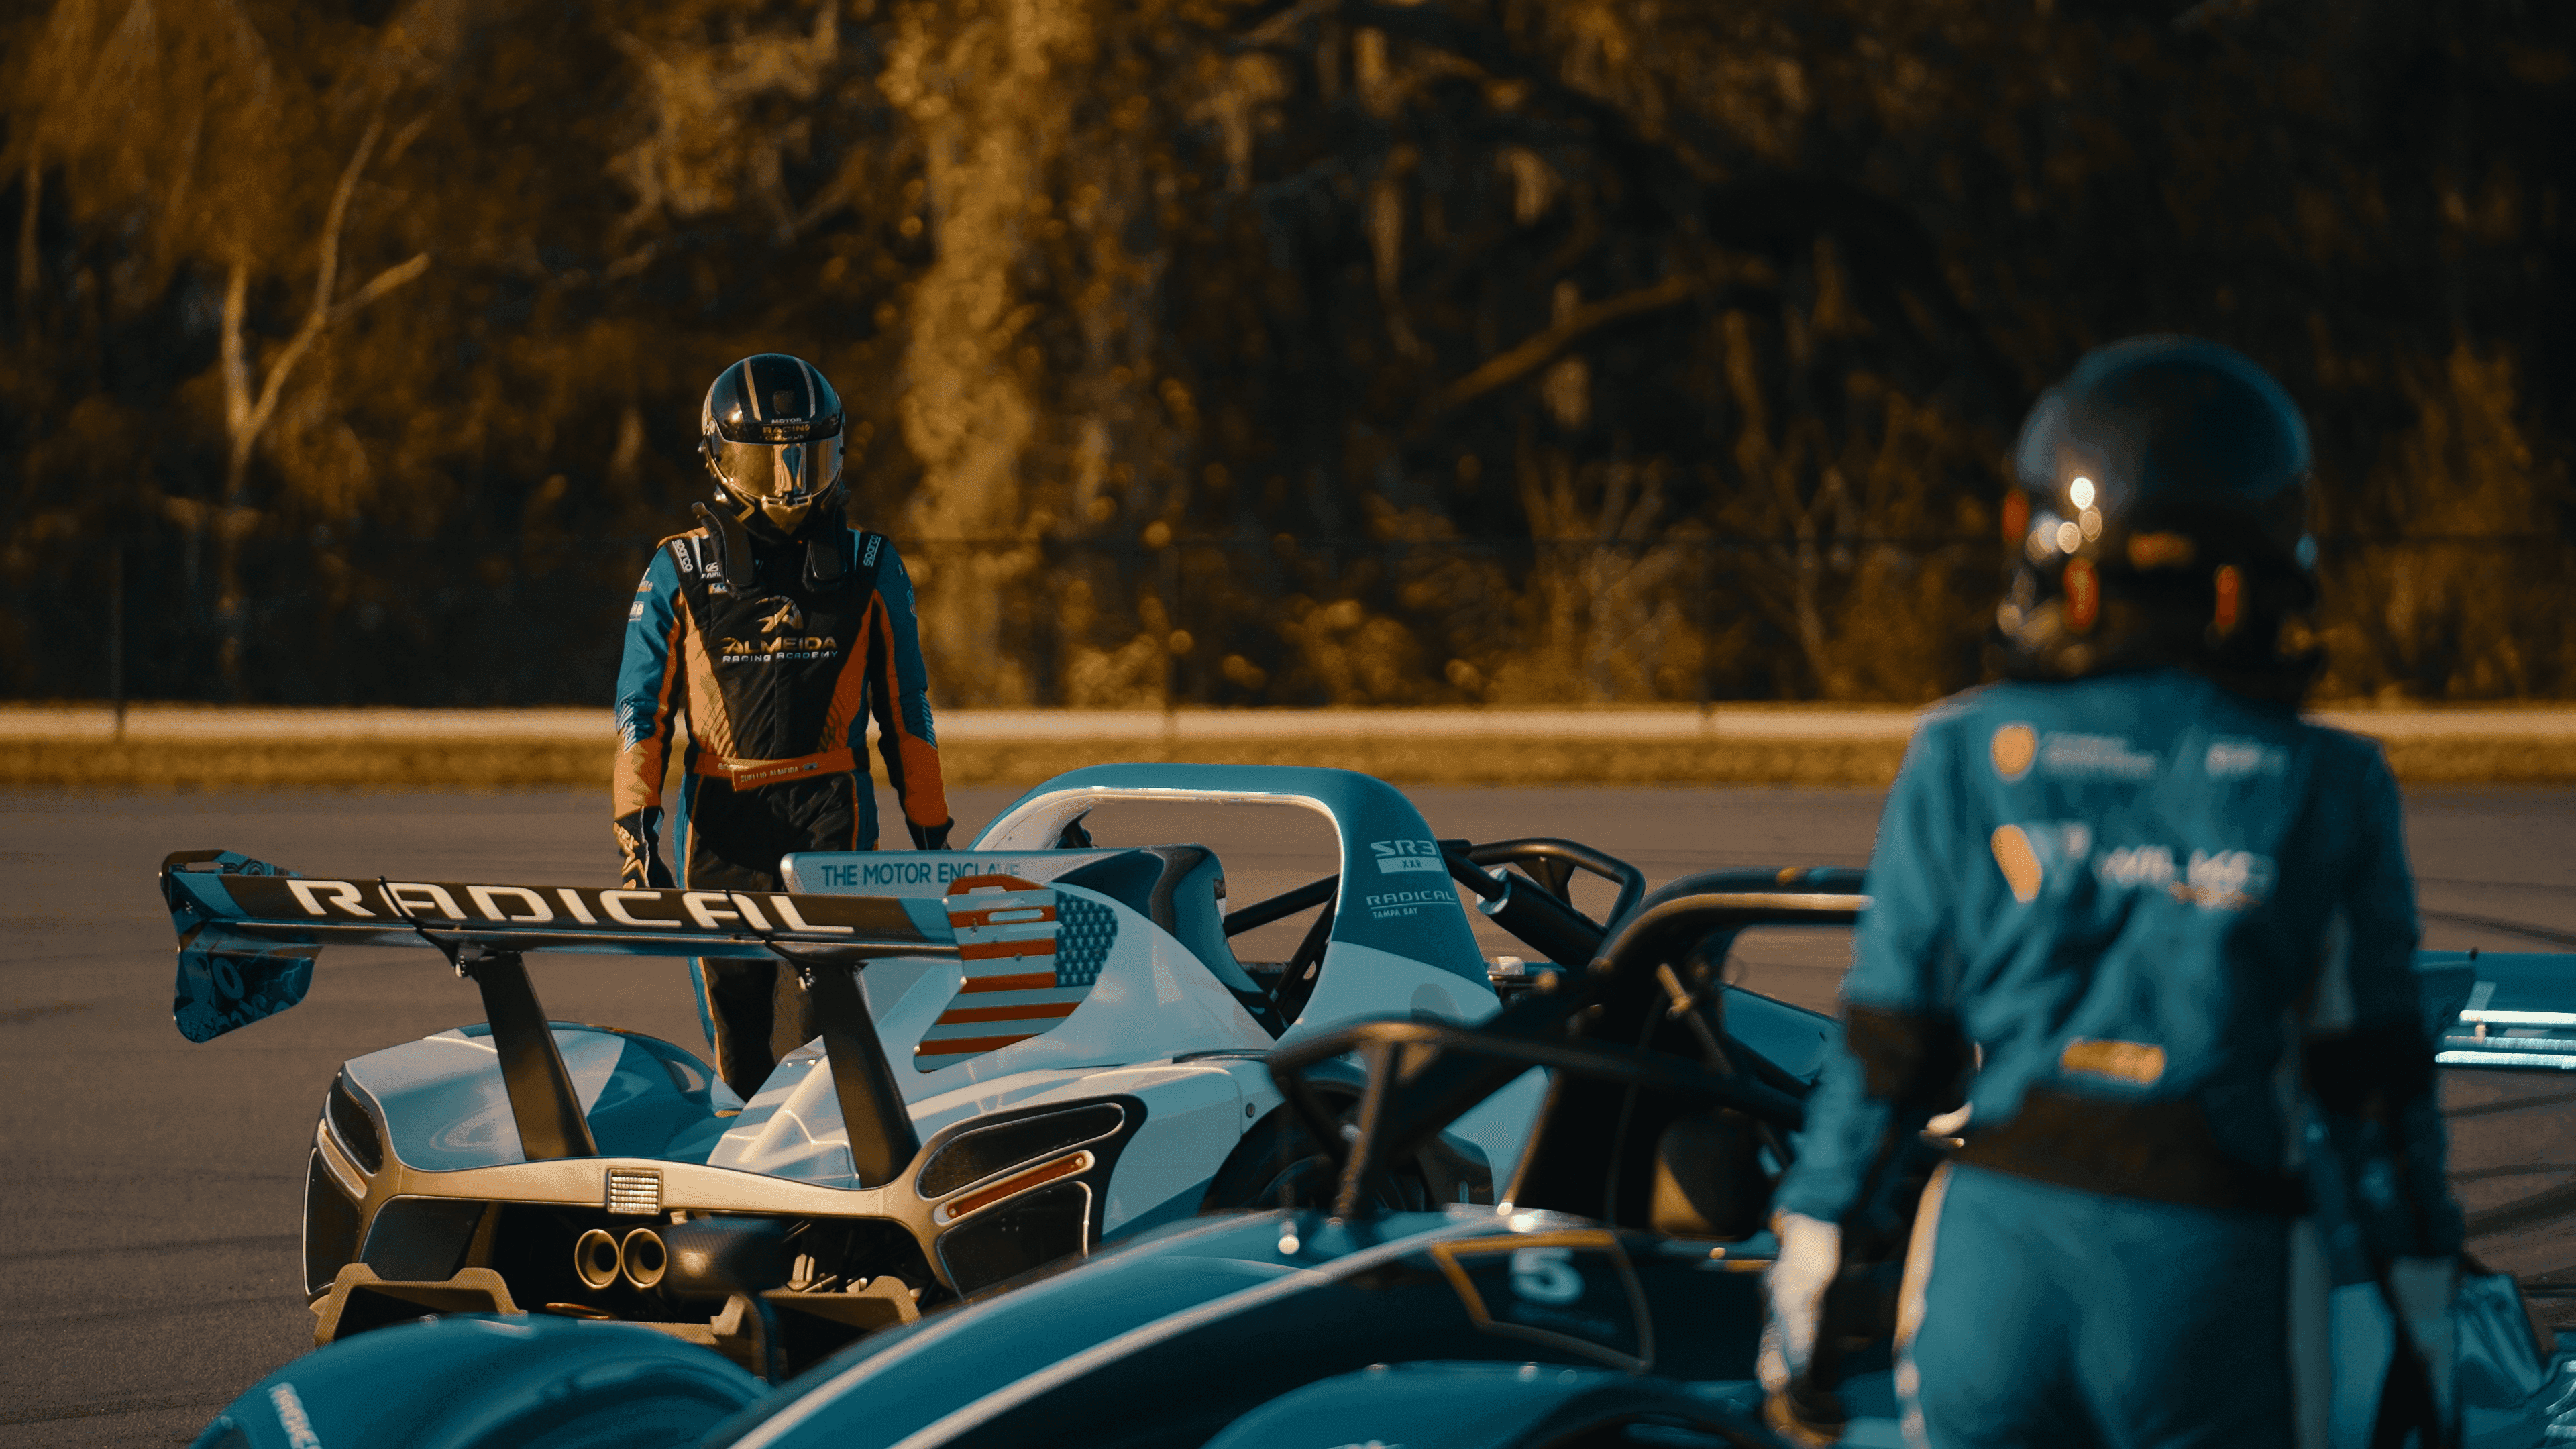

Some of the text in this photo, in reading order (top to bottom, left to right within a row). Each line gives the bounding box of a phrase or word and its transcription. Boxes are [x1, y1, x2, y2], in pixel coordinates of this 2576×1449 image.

[763, 424, 810, 433] RACING
[672, 539, 693, 573] sparco
[863, 535, 881, 568] sparco
[720, 637, 837, 653] ALMEIDA
[722, 651, 837, 663] RACING ACADEMY
[1370, 840, 1437, 857] SR3
[1402, 859, 1422, 869] XXR
[821, 865, 857, 886] THE
[863, 863, 931, 885] MOTOR
[1366, 890, 1456, 905] RADICAL
[285, 879, 855, 933] RADICAL
[1373, 907, 1417, 918] TAMPA BAY
[1512, 1246, 1584, 1303] 5
